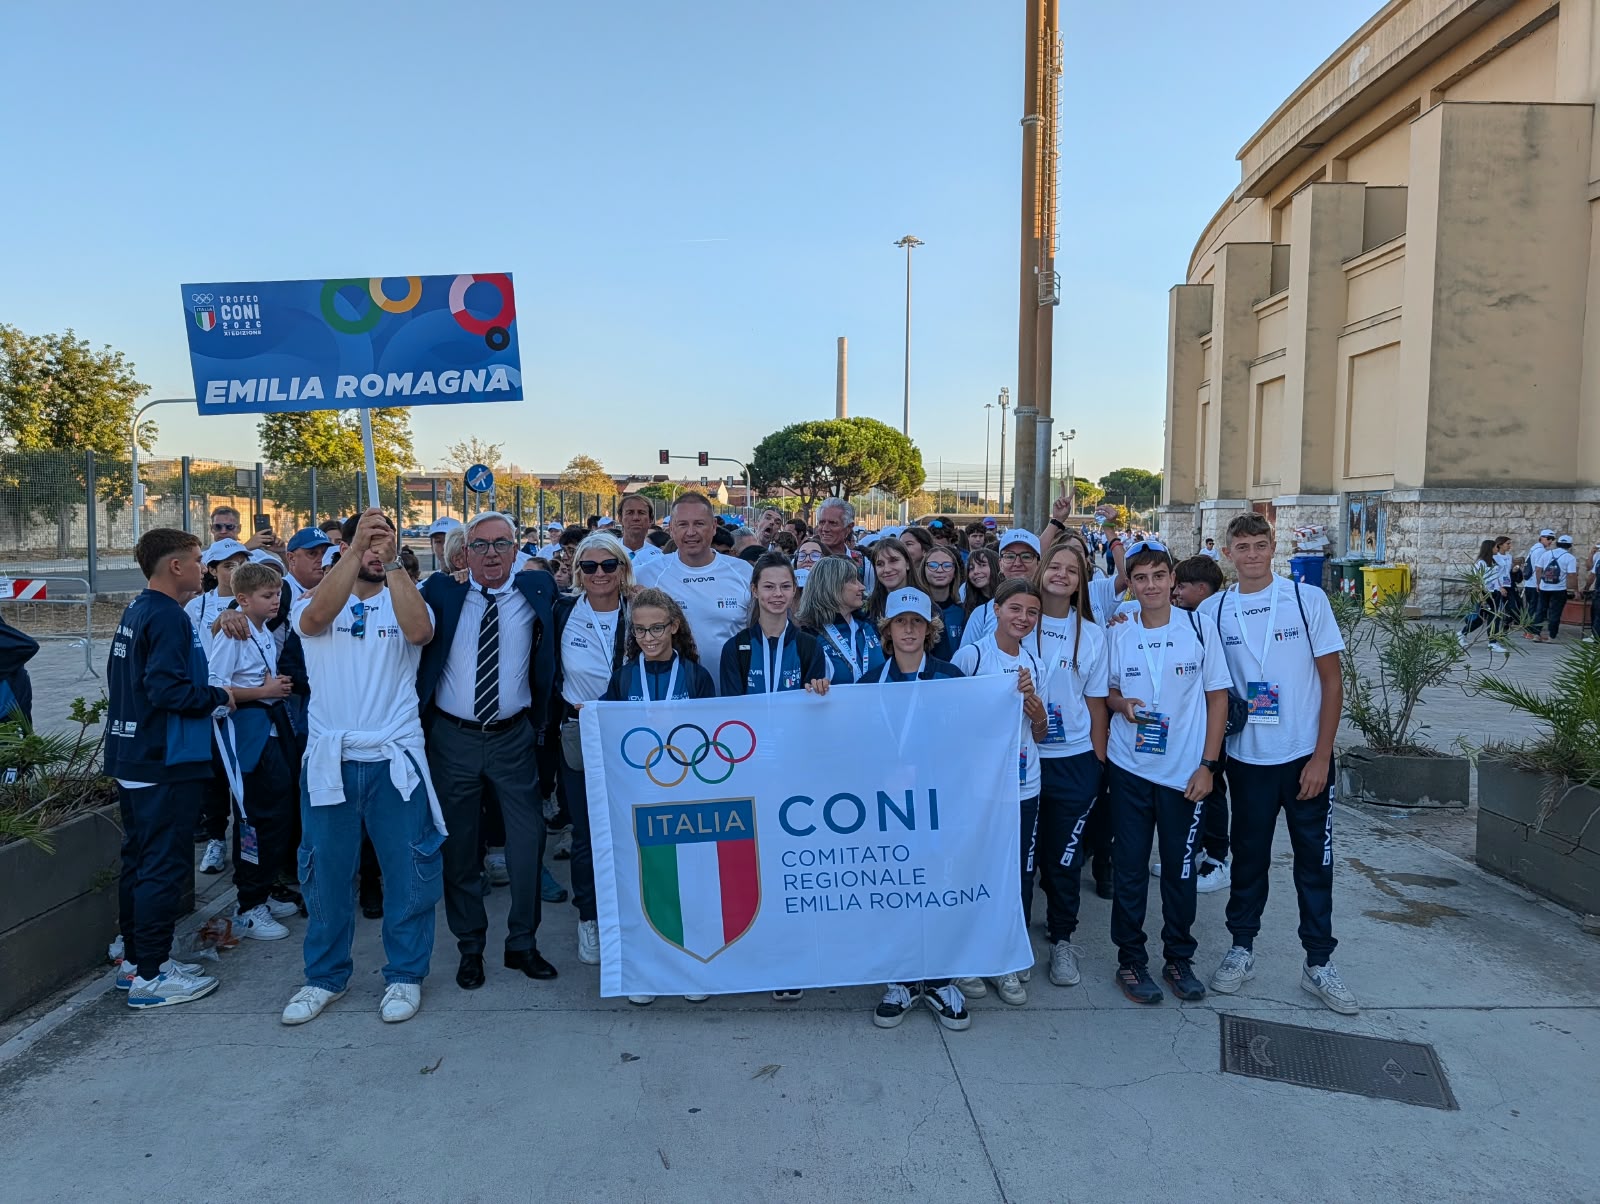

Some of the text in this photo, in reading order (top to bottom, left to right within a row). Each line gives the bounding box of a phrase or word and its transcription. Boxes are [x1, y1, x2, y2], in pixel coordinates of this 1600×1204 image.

[219, 295, 259, 304] TROFEO
[221, 304, 261, 321] CONI
[222, 321, 262, 330] 2026
[205, 369, 511, 404] EMILIA ROMAGNA
[647, 809, 747, 838] ITALIA
[778, 788, 940, 838] CONI
[781, 844, 911, 869] COMITATO
[784, 868, 927, 892] REGIONALE
[786, 884, 992, 915] EMILIA ROMAGNA
